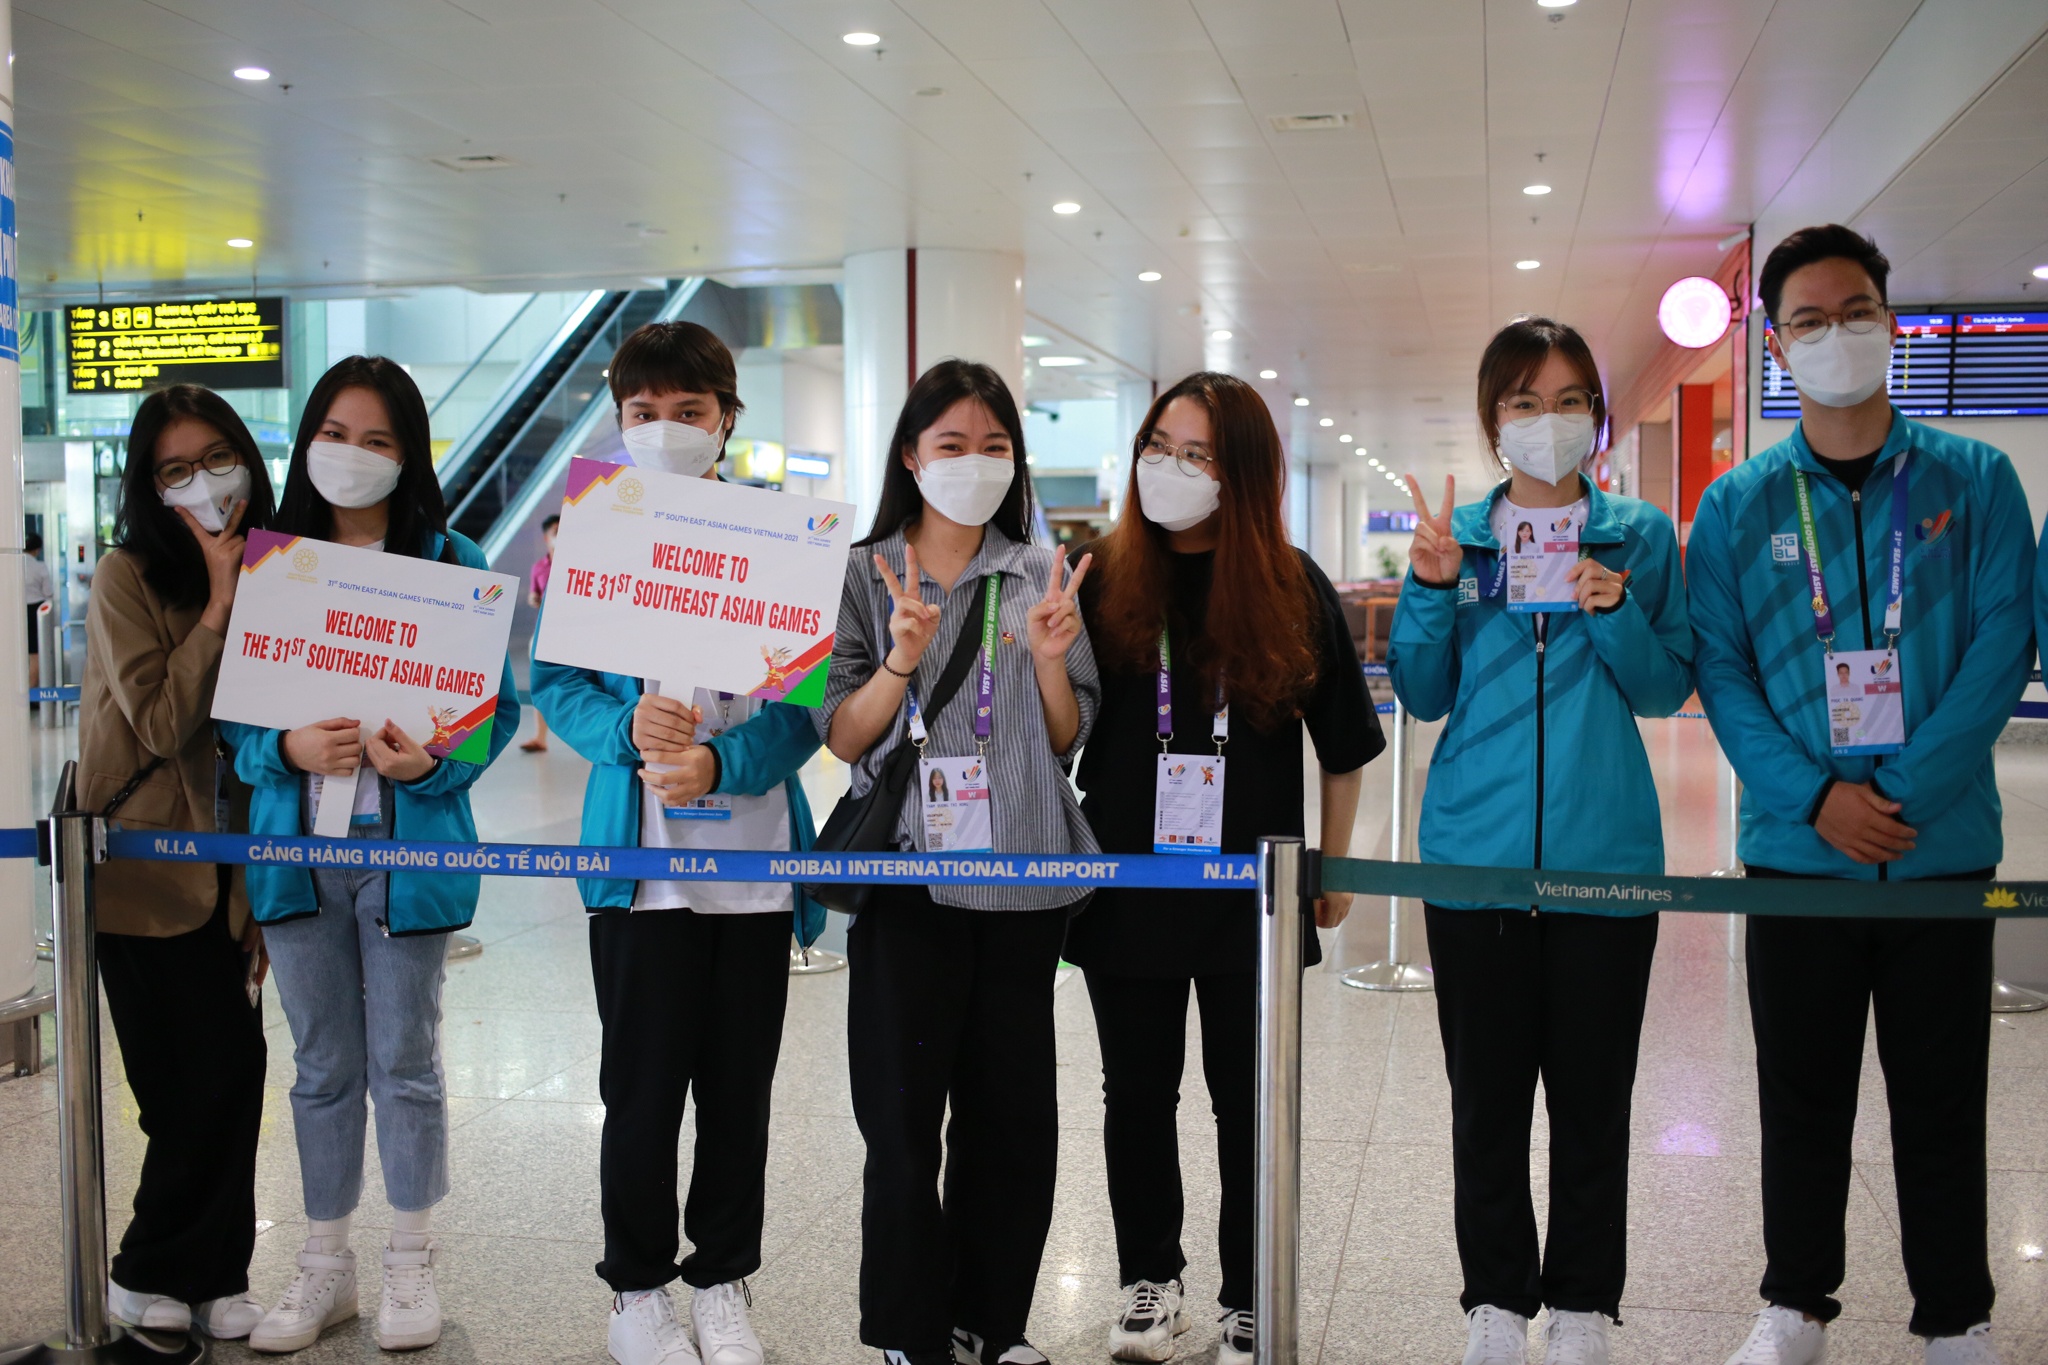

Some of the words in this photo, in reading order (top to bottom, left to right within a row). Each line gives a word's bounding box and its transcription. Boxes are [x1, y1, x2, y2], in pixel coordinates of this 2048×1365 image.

[98, 310, 110, 328] 3
[99, 340, 110, 358] 2
[101, 370, 110, 387] 1
[666, 513, 689, 524] SOUTH
[689, 517, 707, 527] EAST
[707, 520, 728, 530] ASIAN
[729, 524, 752, 535] GAMES
[753, 528, 783, 540] VIETNAM
[784, 533, 799, 542] 2021
[1797, 478, 1811, 522] STRONGER
[1804, 524, 1820, 574] SOUTHEAST
[1812, 574, 1822, 596] ASIA
[652, 542, 727, 581] WELCOME
[731, 556, 749, 584] TO
[1894, 548, 1902, 565] SEA
[1496, 561, 1506, 588] GAMES
[1891, 565, 1900, 595] GAMES
[339, 581, 360, 592] SOUTH
[361, 586, 377, 595] EAST
[378, 589, 398, 599] ASIAN
[398, 593, 421, 603] GAMES
[422, 597, 451, 608] VIETNAM
[451, 602, 465, 611] 2021
[566, 568, 596, 598] THE
[597, 573, 632, 601] 31ST
[633, 579, 719, 619] SOUTHEAST
[719, 595, 765, 627] ASIAN
[768, 602, 821, 636] GAMES
[988, 578, 997, 622] STRONGER
[325, 608, 396, 645] WELCOME
[399, 622, 418, 648] TO
[982, 623, 994, 673] SOUTHEAST
[242, 631, 271, 660] THE
[272, 637, 306, 664] 31ST
[306, 642, 389, 681] SOUTHEAST
[389, 658, 433, 688] ASIAN
[435, 666, 485, 698] GAMES
[40, 690, 59, 699] N.I.A
[982, 674, 990, 695] ASIA
[1160, 672, 1168, 693] ASIA
[154, 838, 198, 856] N.I.A
[249, 840, 303, 862] CẢNG
[309, 844, 364, 865] HÀNG
[369, 846, 438, 868] KHÔNG
[444, 846, 500, 869] QUỐC
[506, 848, 530, 870] TẾ
[535, 852, 570, 875] NỘI
[577, 851, 610, 872] BÀI
[670, 857, 718, 873] N.I.A
[770, 859, 841, 875] NOIBAI
[848, 860, 1018, 878] INTERNATIONAL
[1024, 861, 1120, 879] AIRPORT
[1203, 862, 1256, 880] N.I.A
[1535, 881, 1605, 899] Vietnam
[1607, 885, 1672, 901] Airlines
